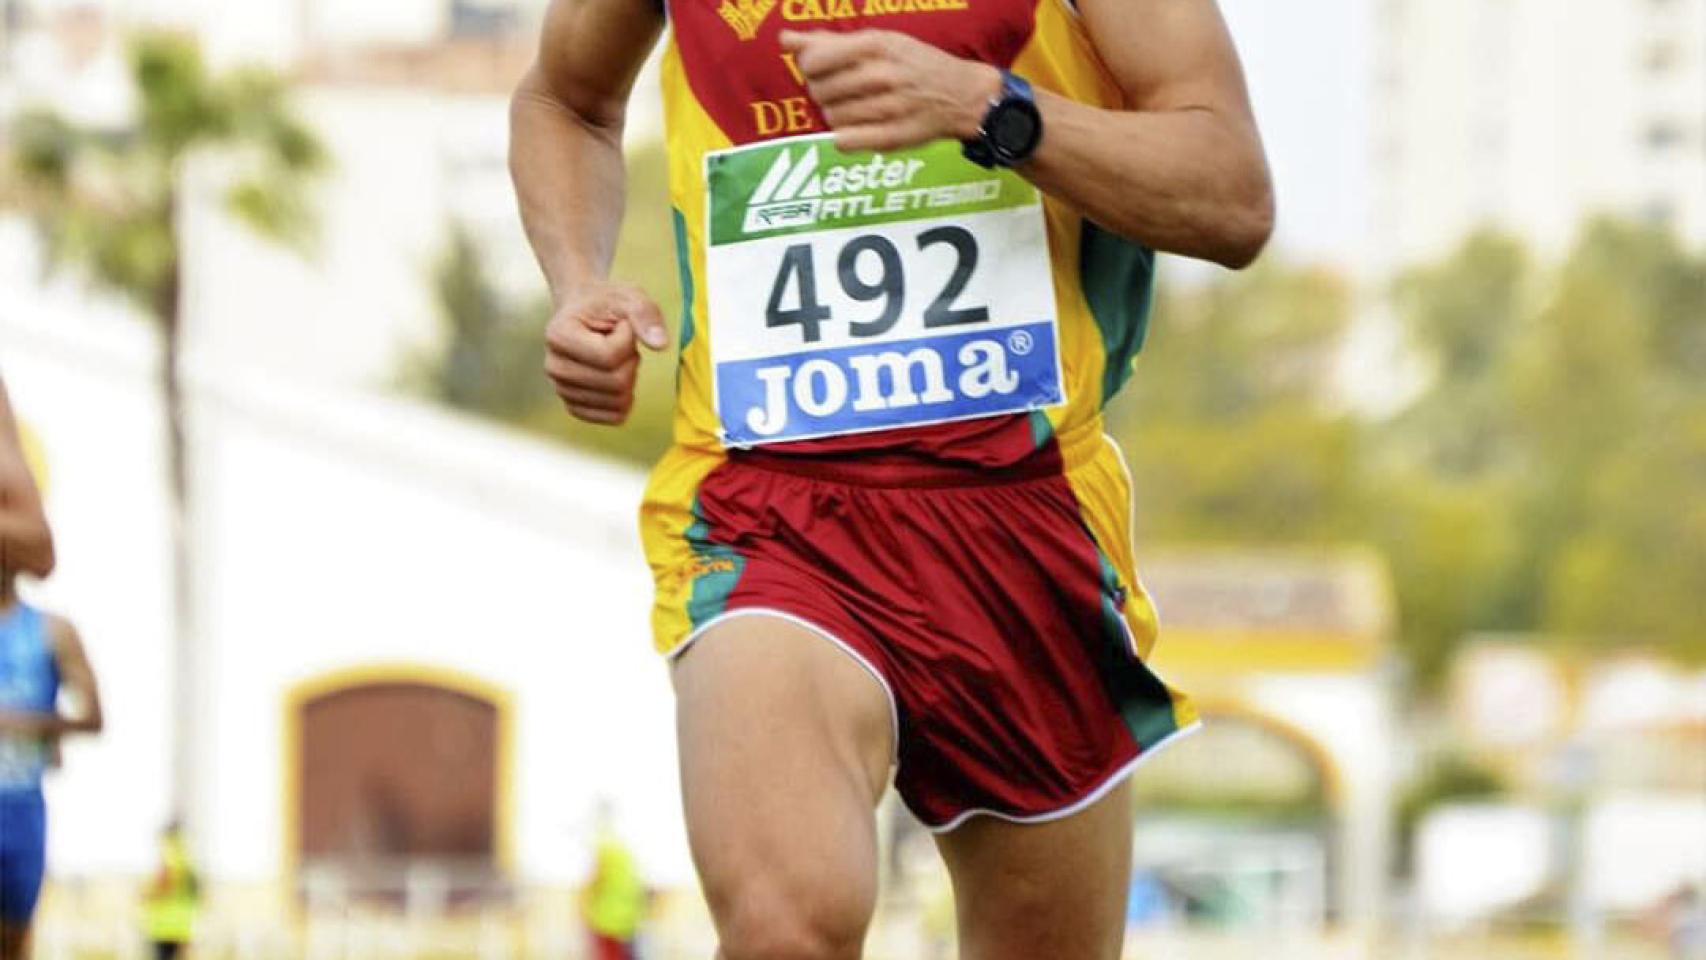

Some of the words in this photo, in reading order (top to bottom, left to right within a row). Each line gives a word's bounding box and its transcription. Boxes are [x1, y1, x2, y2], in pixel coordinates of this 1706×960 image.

[782, 0, 856, 20] CAJA
[750, 97, 813, 135] DE
[748, 144, 924, 202] Master
[765, 225, 989, 343] 492
